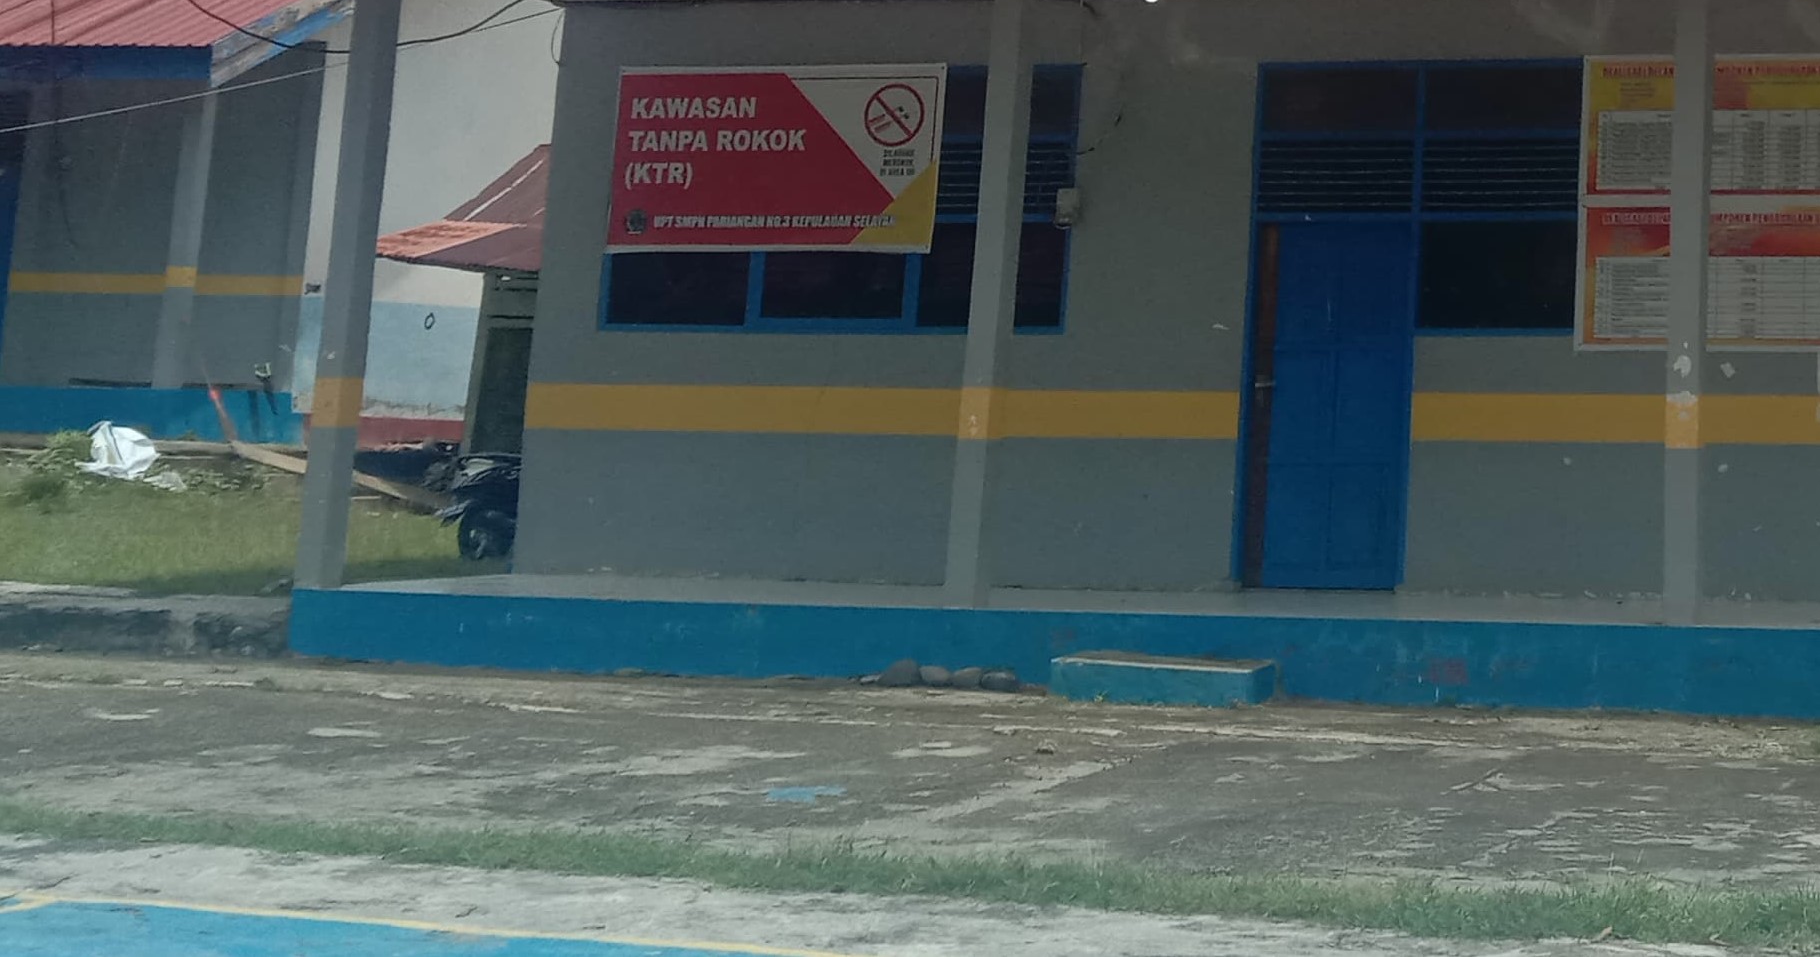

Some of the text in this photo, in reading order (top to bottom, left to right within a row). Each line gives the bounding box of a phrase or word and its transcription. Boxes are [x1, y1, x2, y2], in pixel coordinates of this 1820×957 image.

[631, 96, 757, 119] KAWASAN
[628, 128, 807, 152] TANPA ROKOK
[624, 162, 694, 191] (KTR)
